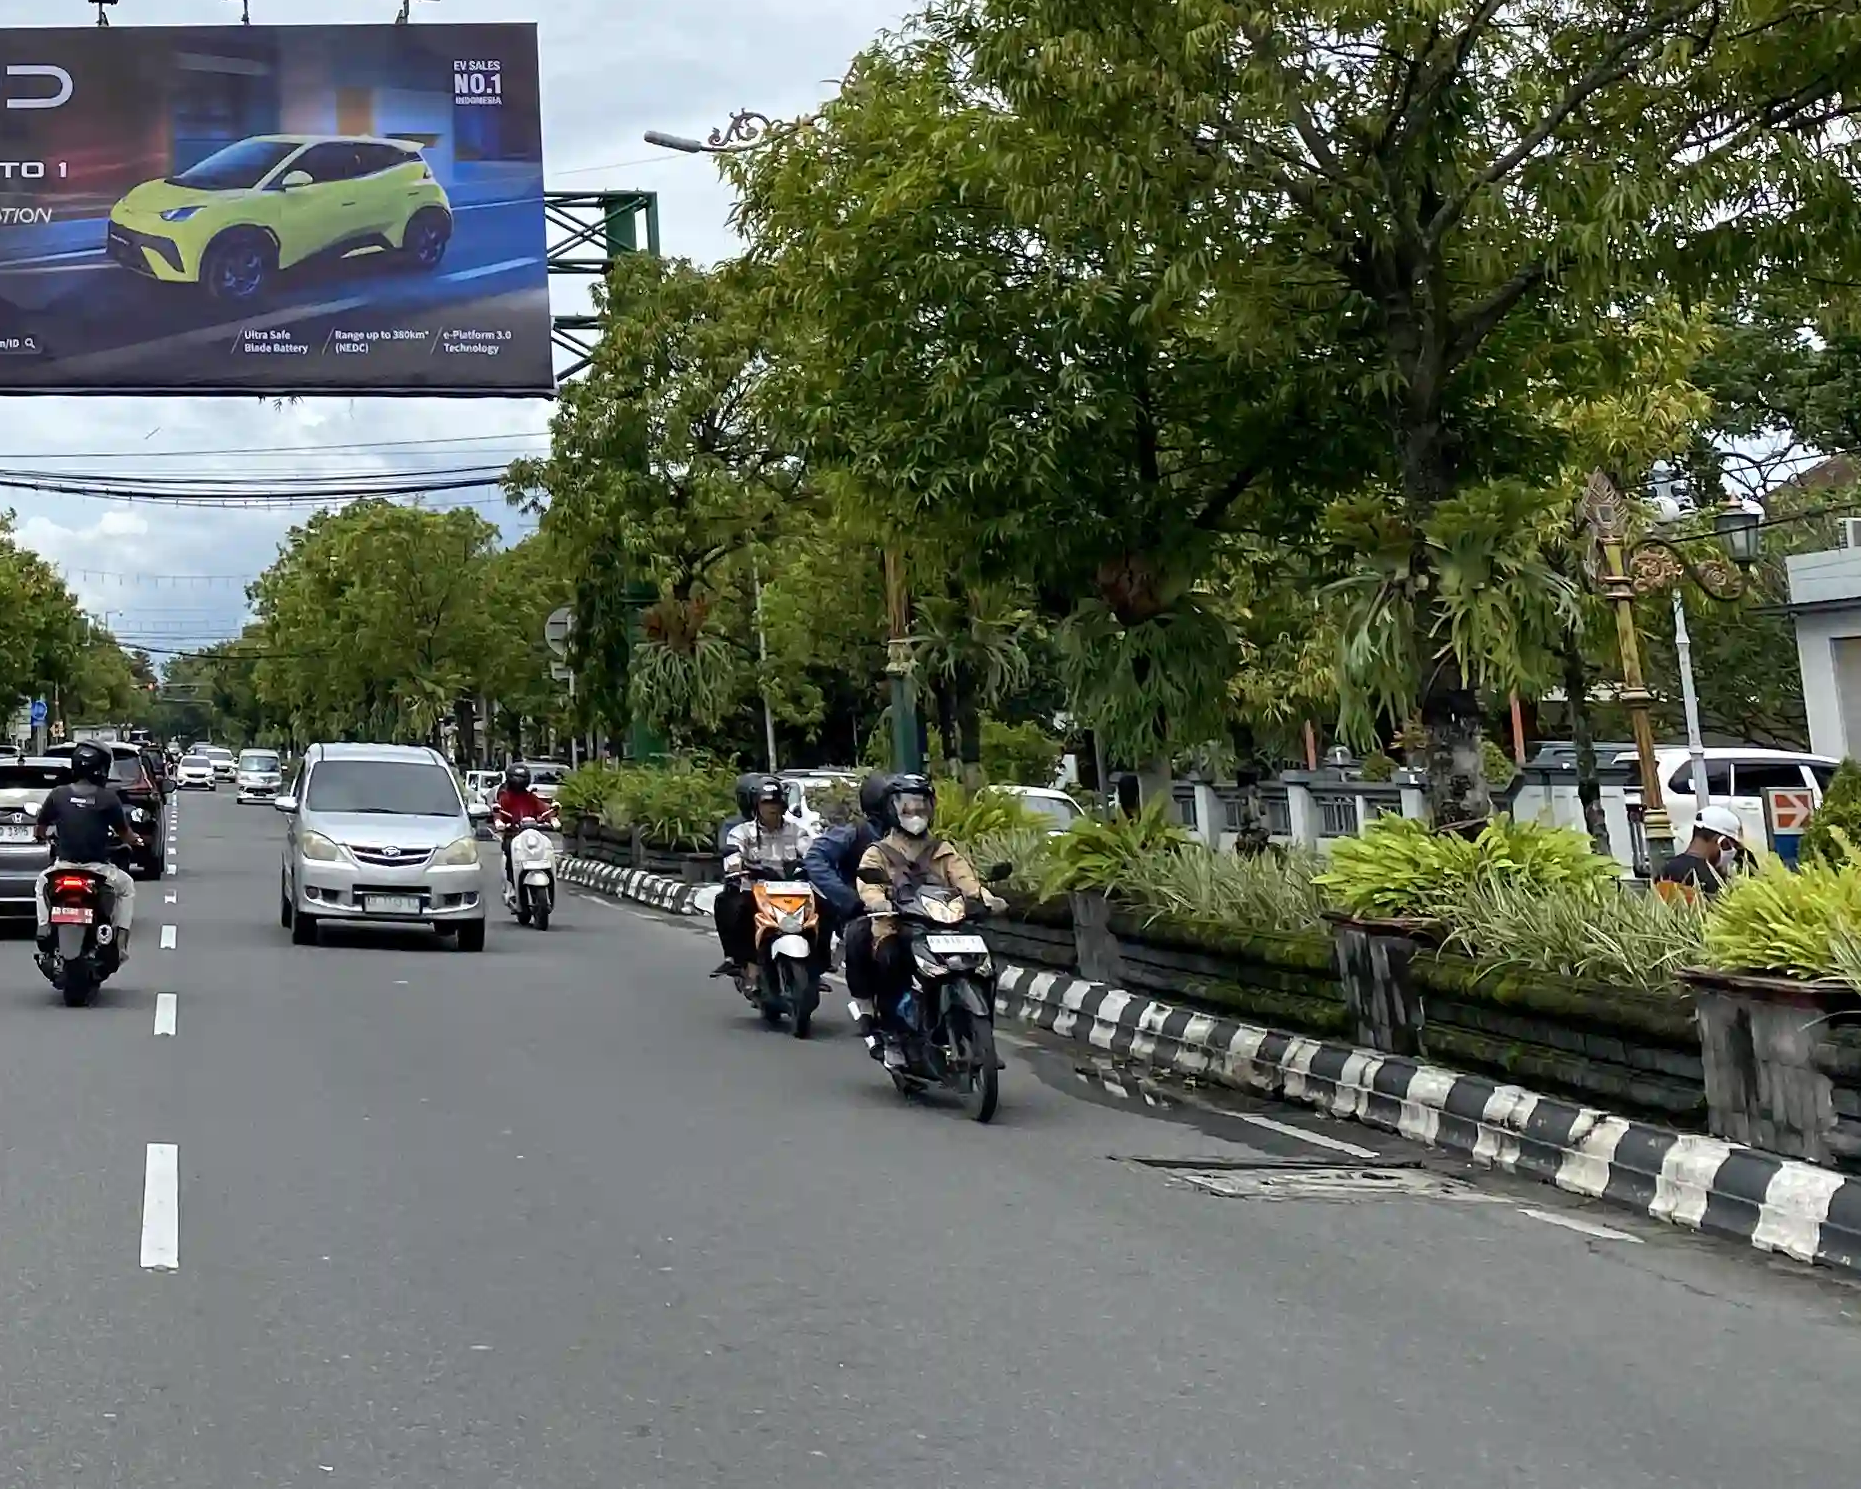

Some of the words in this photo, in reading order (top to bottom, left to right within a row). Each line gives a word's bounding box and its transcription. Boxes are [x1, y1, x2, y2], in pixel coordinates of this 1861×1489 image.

[453, 60, 467, 71] EV
[469, 60, 500, 71] SALES
[454, 73, 502, 94] NO.1
[58, 161, 69, 179] 1
[244, 330, 268, 340] Ultra
[269, 329, 291, 340] Safe
[335, 330, 365, 342] Range
[366, 332, 379, 342] up
[380, 330, 391, 340] to
[443, 330, 495, 341] e-Platform
[496, 330, 512, 340] 3.0
[244, 342, 272, 353] Blade
[273, 342, 308, 355] Battery
[335, 342, 369, 354] (NEDC)
[443, 342, 500, 355] Technology
